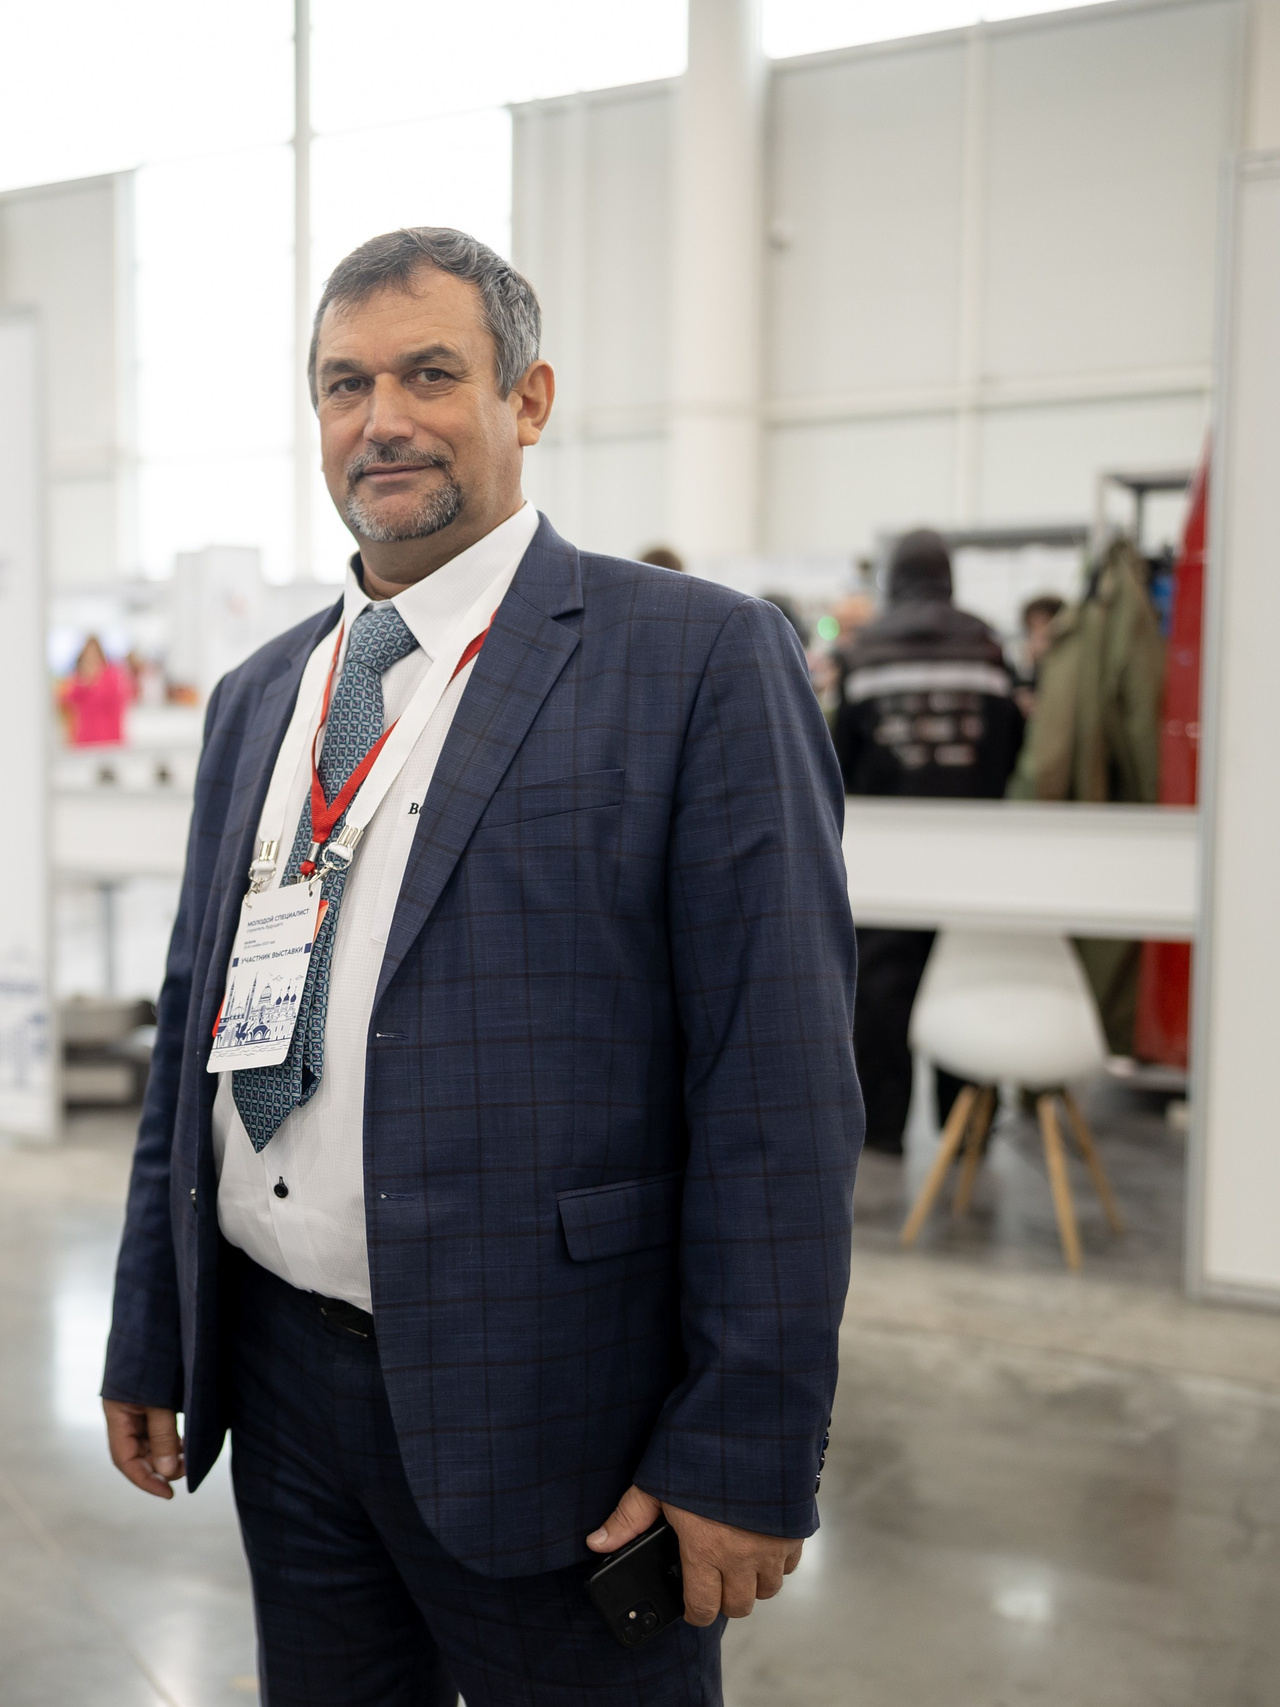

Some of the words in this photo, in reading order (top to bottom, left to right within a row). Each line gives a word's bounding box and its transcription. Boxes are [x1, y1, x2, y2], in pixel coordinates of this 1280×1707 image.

[247, 915, 274, 927] МОЛОДОЙ
[274, 908, 310, 921] СПЕЦИАЛИСТ
[241, 953, 271, 965] УЧАСТНИК
[271, 946, 304, 959] ВЫСТАВКИ
